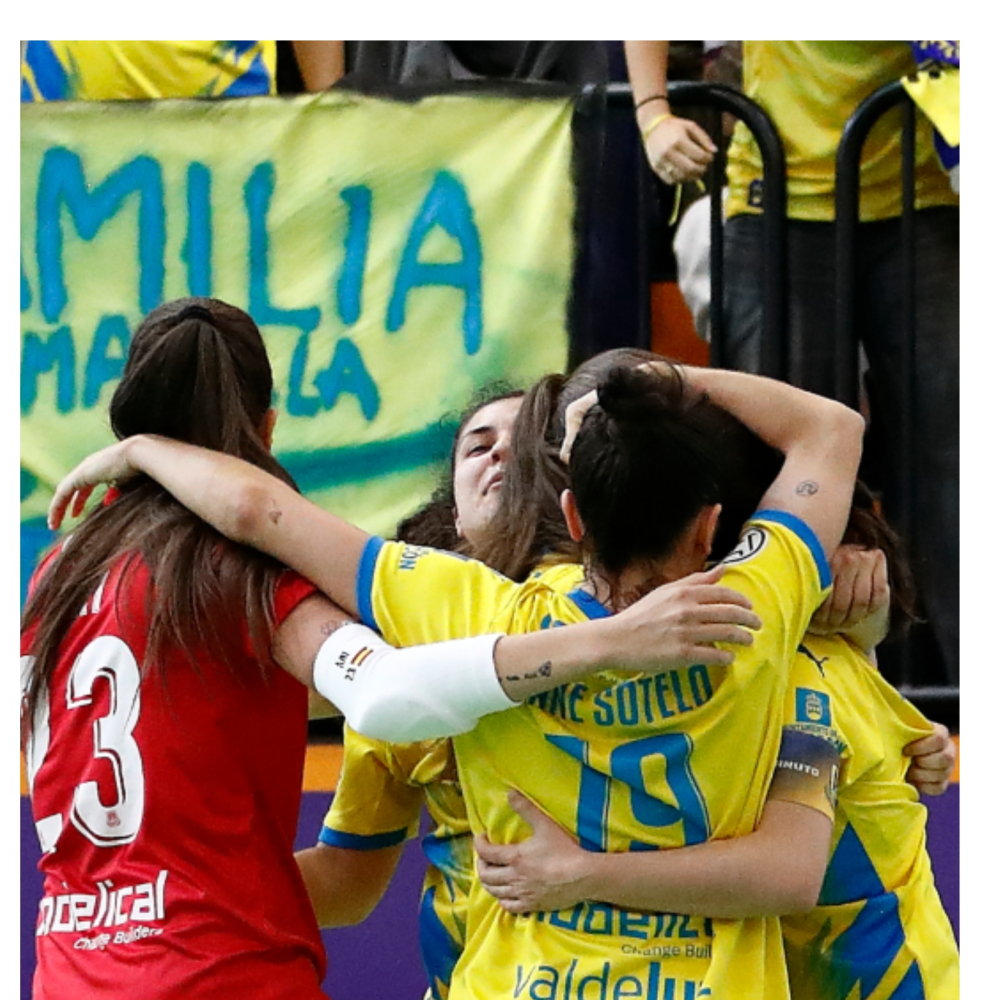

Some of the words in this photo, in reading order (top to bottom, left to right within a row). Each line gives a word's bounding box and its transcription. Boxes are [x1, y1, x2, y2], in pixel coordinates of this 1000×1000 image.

[20, 146, 484, 355] MILIA
[593, 664, 713, 726] SOTELO
[545, 733, 712, 852] 19
